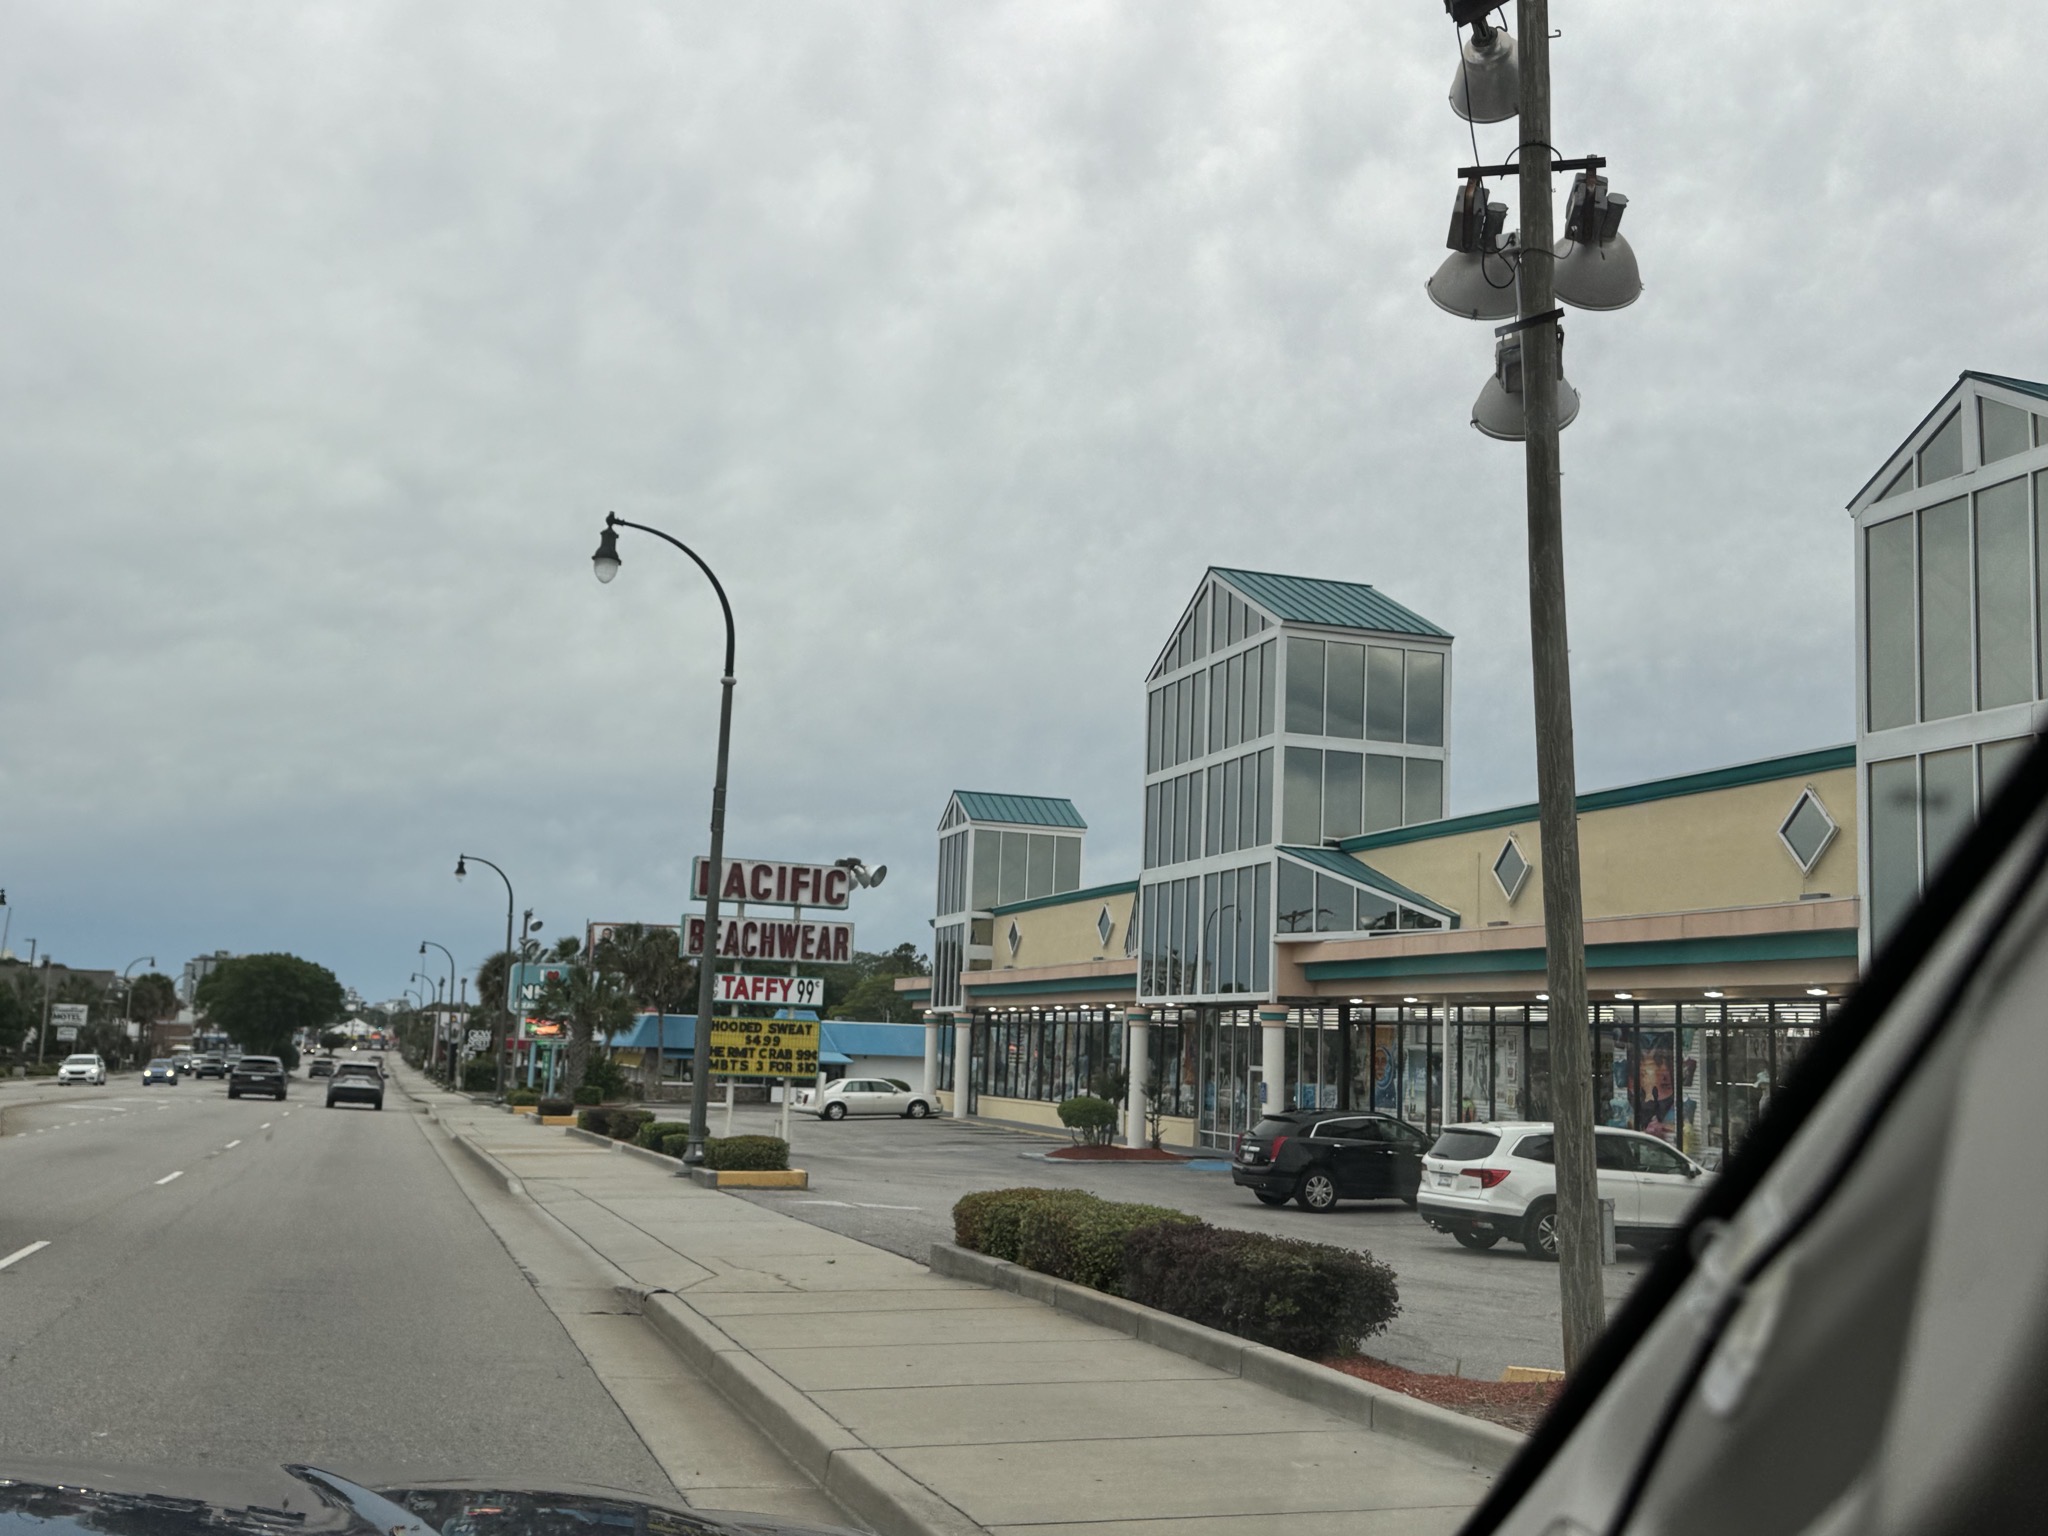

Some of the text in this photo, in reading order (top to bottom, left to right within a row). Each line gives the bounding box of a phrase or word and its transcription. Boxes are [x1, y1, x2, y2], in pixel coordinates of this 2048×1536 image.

[722, 975, 794, 1002] TAFFY
[797, 979, 820, 1004] 99¢
[711, 1020, 812, 1036] HOODED SWEAT
[758, 1048, 793, 1060] CRAB
[756, 1061, 763, 1072] 3
[768, 1062, 793, 1073] FOR
[797, 1063, 816, 1073] $10
